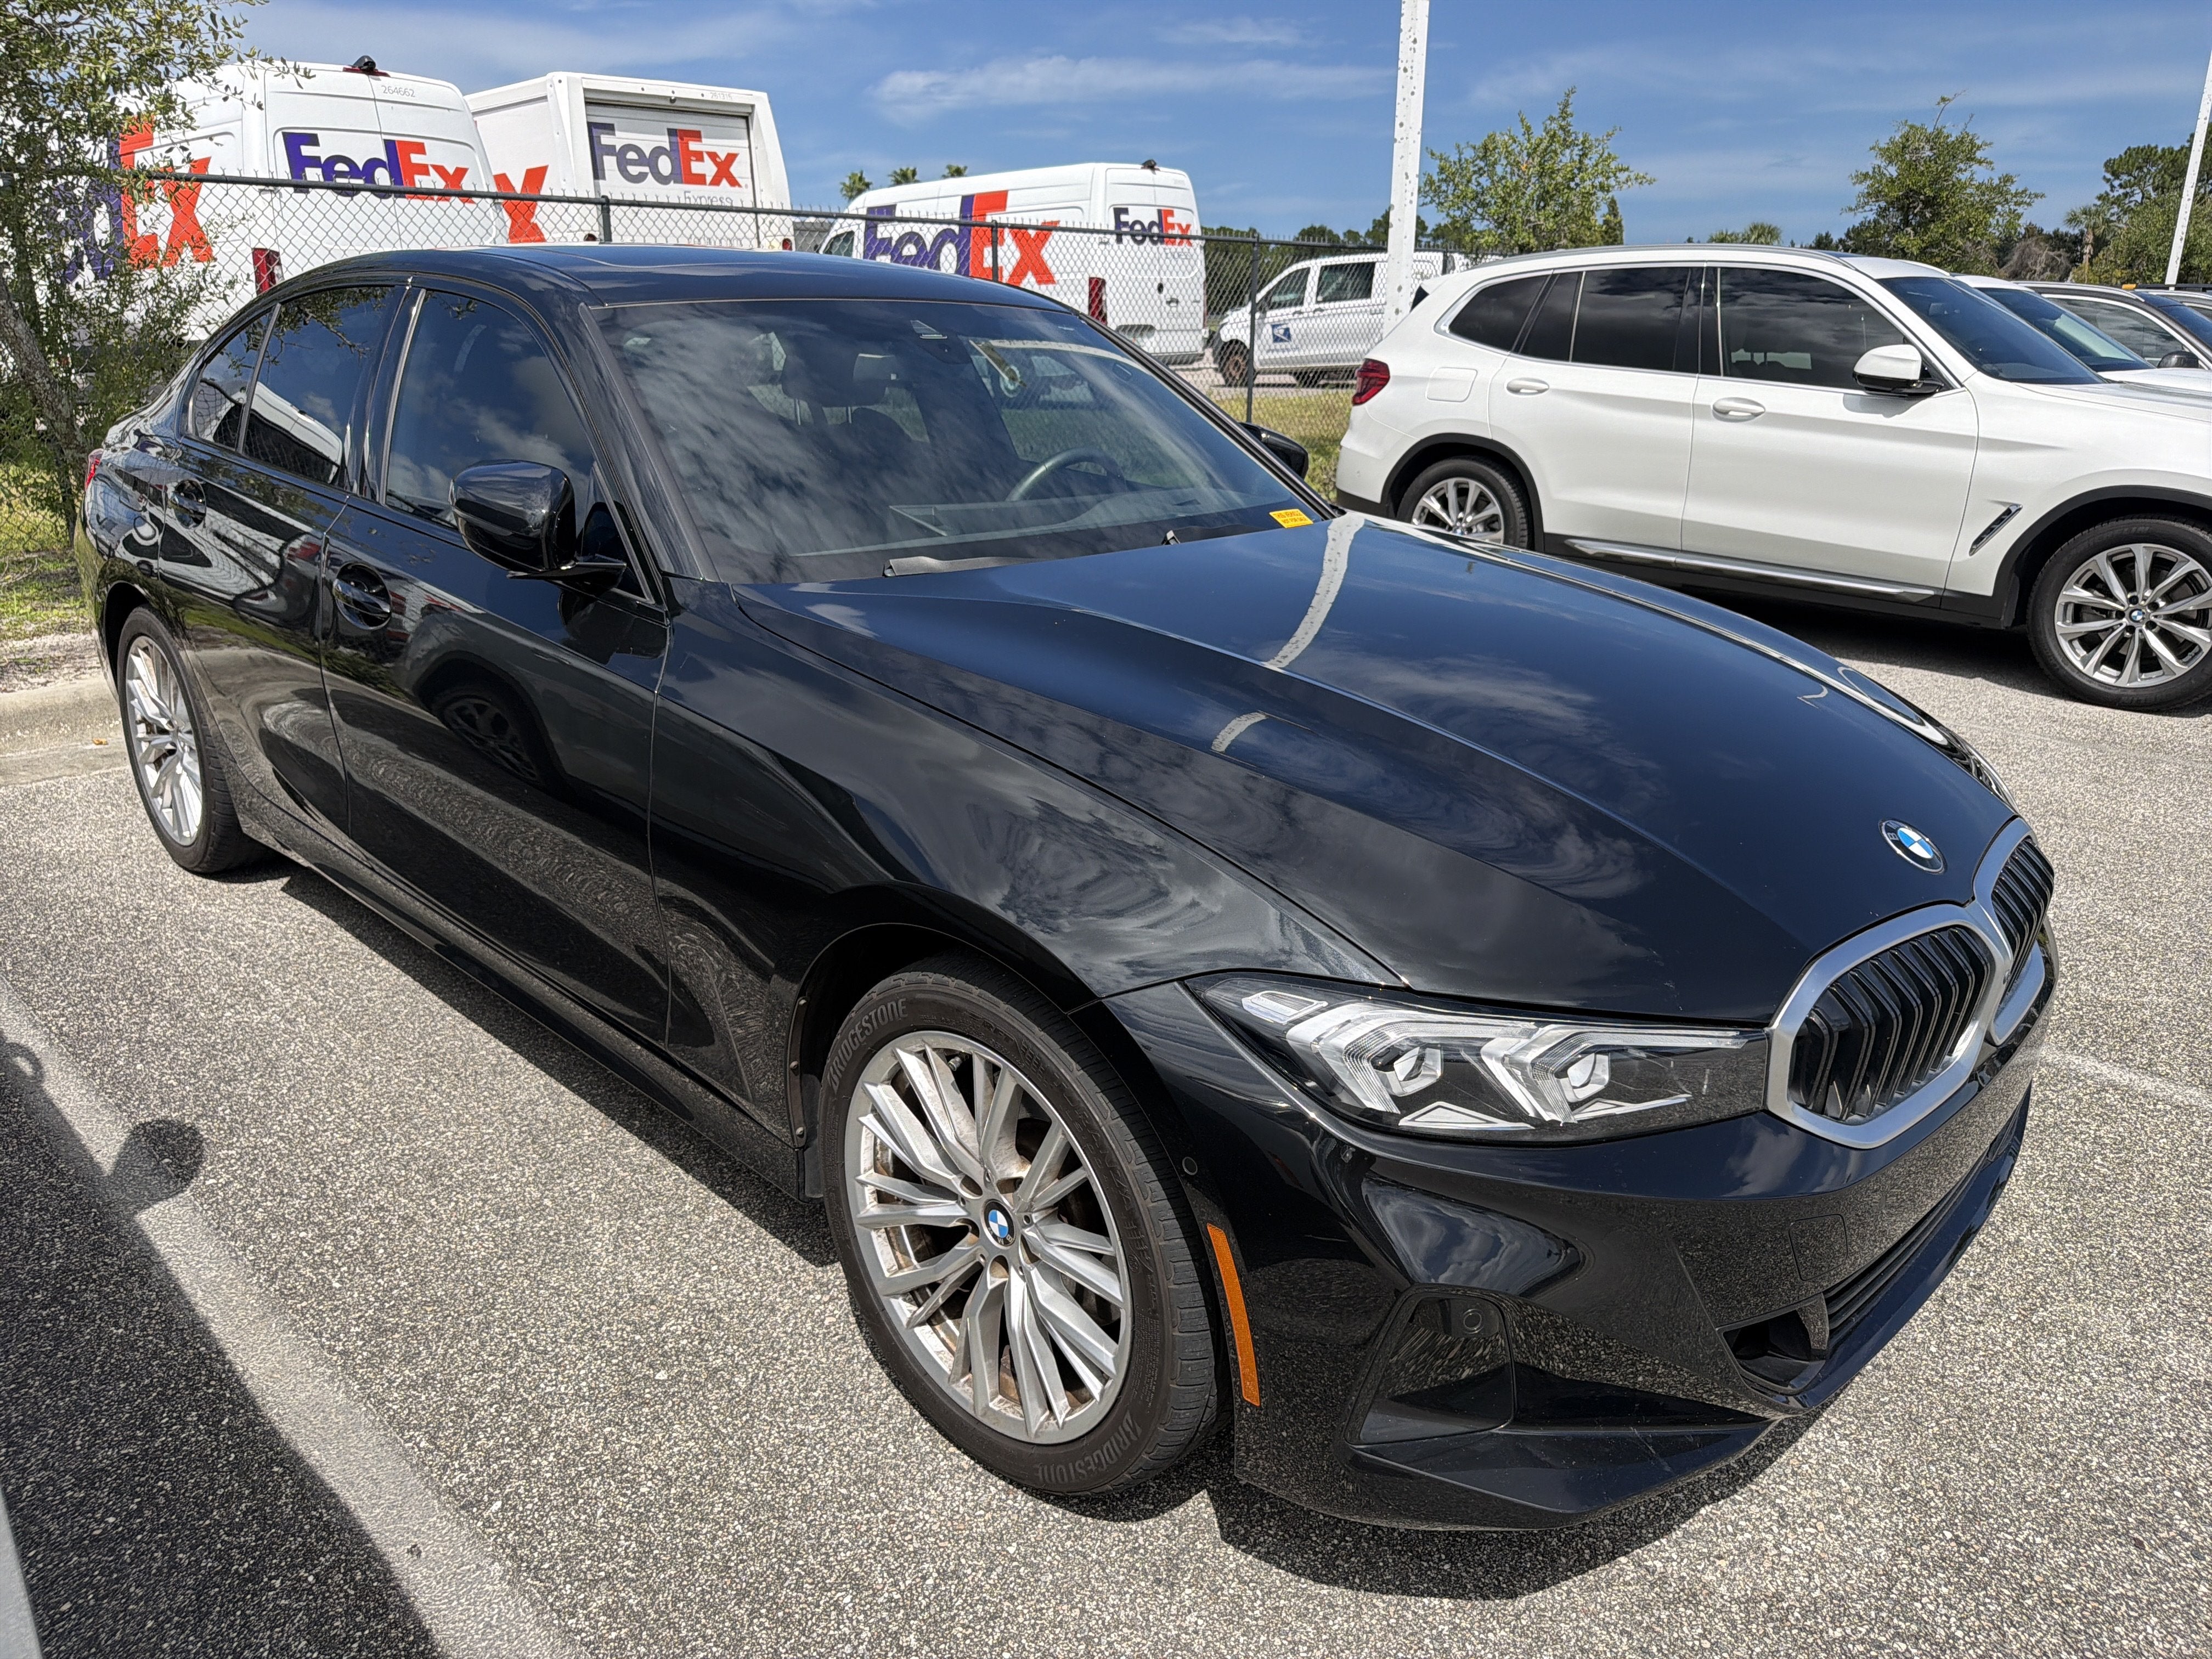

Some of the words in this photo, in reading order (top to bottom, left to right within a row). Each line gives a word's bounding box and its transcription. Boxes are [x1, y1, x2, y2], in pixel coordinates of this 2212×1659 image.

[381, 84, 416, 98] 264662
[282, 132, 476, 204] FedEx
[587, 122, 742, 188] FedEx
[864, 190, 1060, 287] FedEx
[1113, 207, 1193, 247] FedEx
[827, 997, 908, 1095] BRIDGESTONE
[1034, 1410, 1143, 1484] BRIDGESTONE
